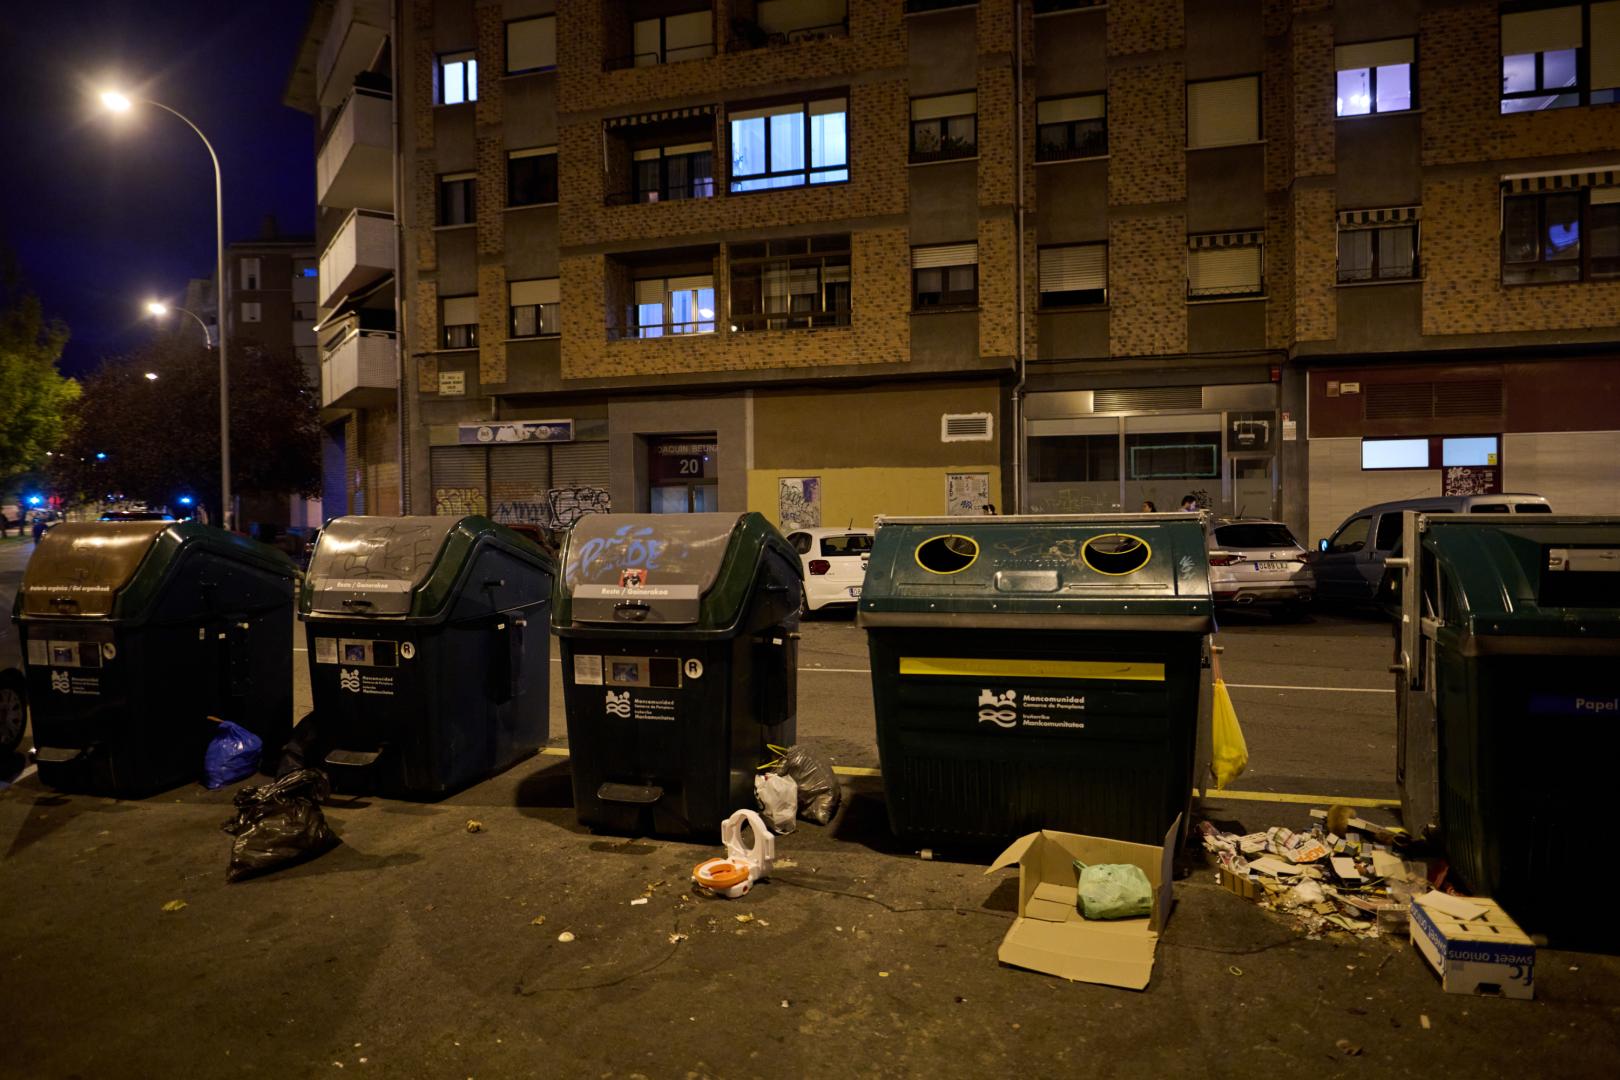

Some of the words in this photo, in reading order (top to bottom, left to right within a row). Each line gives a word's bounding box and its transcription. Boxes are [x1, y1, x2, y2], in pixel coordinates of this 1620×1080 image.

[680, 459, 699, 474] 20
[1023, 695, 1085, 703] Mancomunidad
[1575, 697, 1619, 713] Papel
[1023, 720, 1085, 728] Mankomunitatea
[1448, 950, 1490, 962] onions
[1494, 952, 1533, 965] sweet
